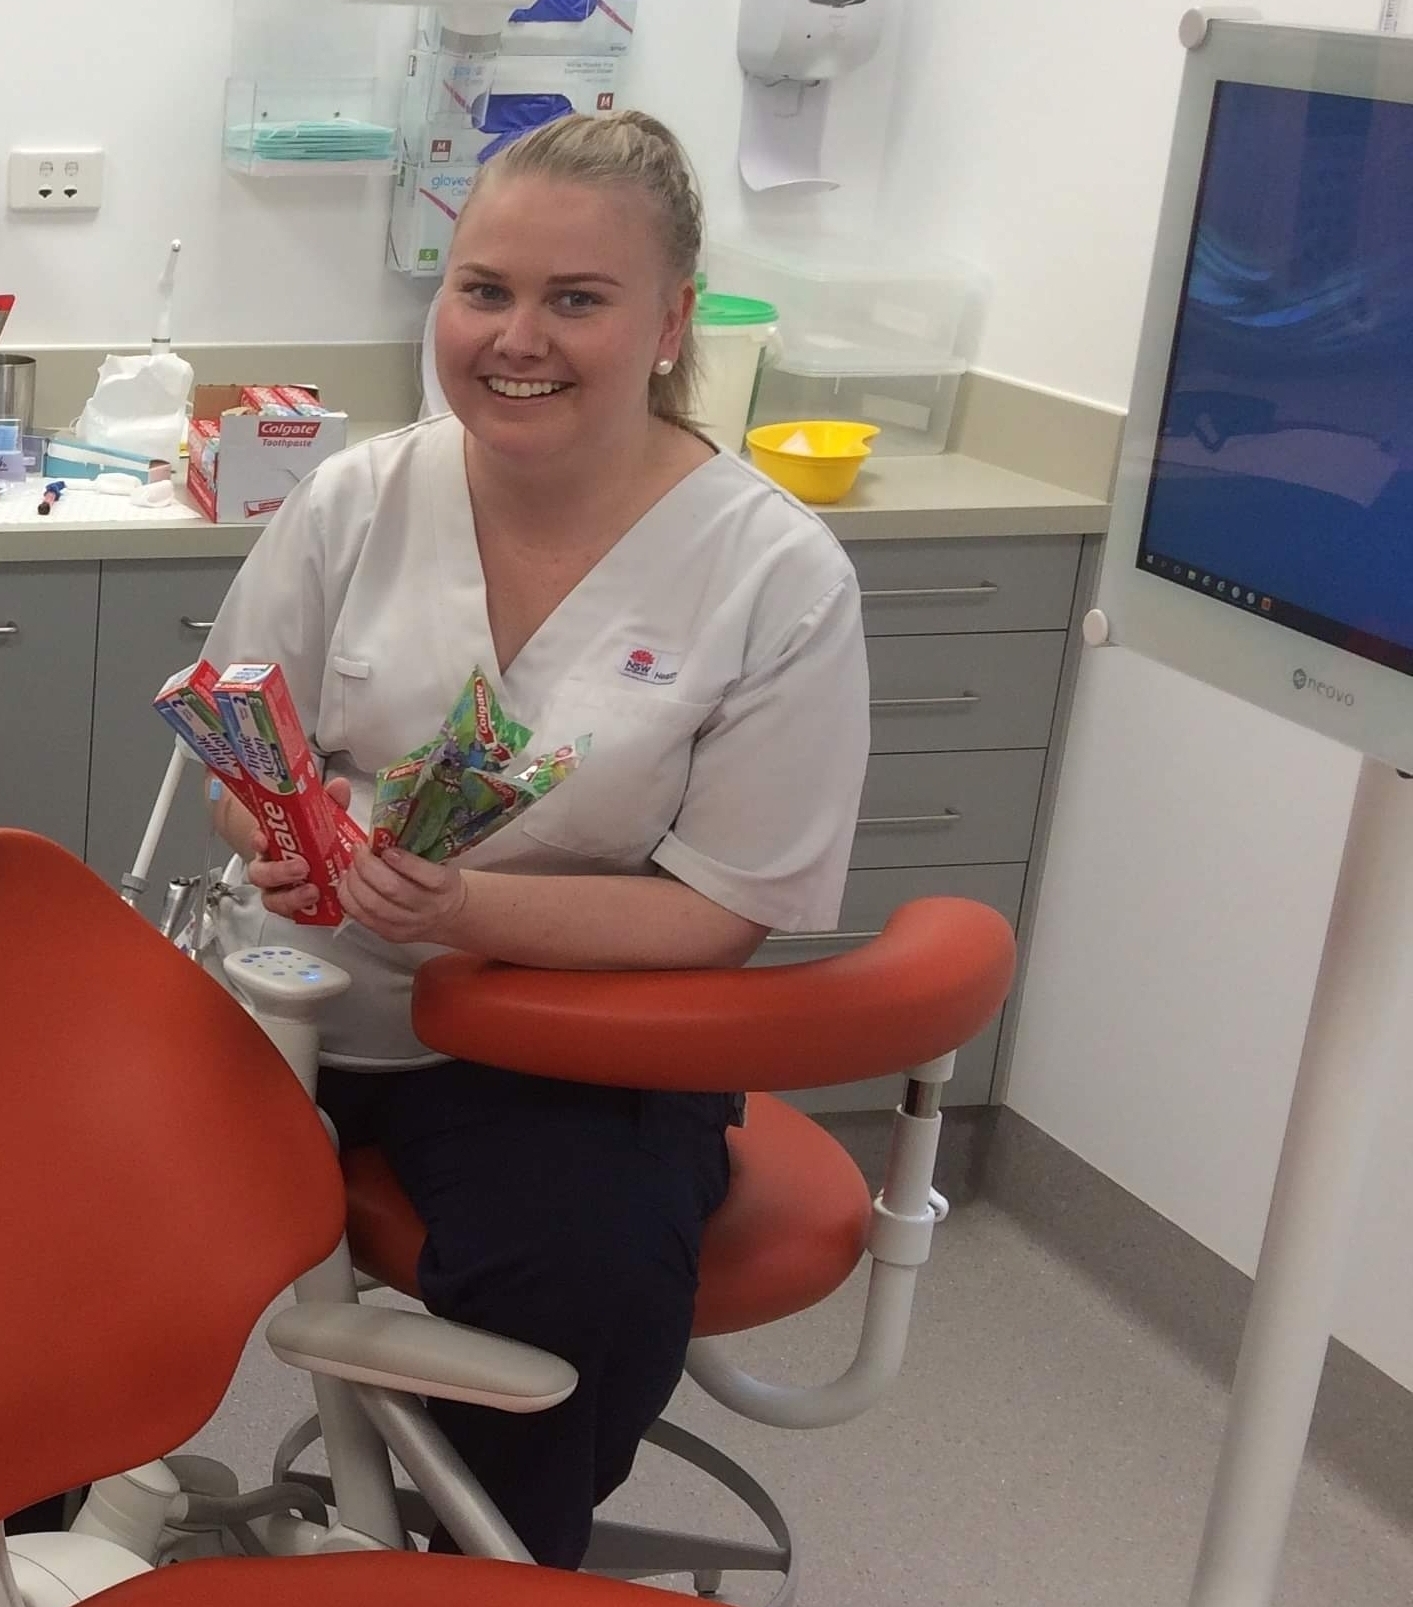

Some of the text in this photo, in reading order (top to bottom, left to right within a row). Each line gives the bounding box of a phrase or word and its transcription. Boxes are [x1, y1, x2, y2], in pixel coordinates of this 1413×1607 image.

[599, 95, 610, 108] M
[436, 142, 447, 152] M
[260, 423, 313, 436] Colgate
[262, 438, 312, 448] Toothpaste
[625, 660, 651, 673] NSW
[475, 684, 491, 734] Colgate
[238, 732, 261, 770] Triple
[254, 737, 276, 778] Action
